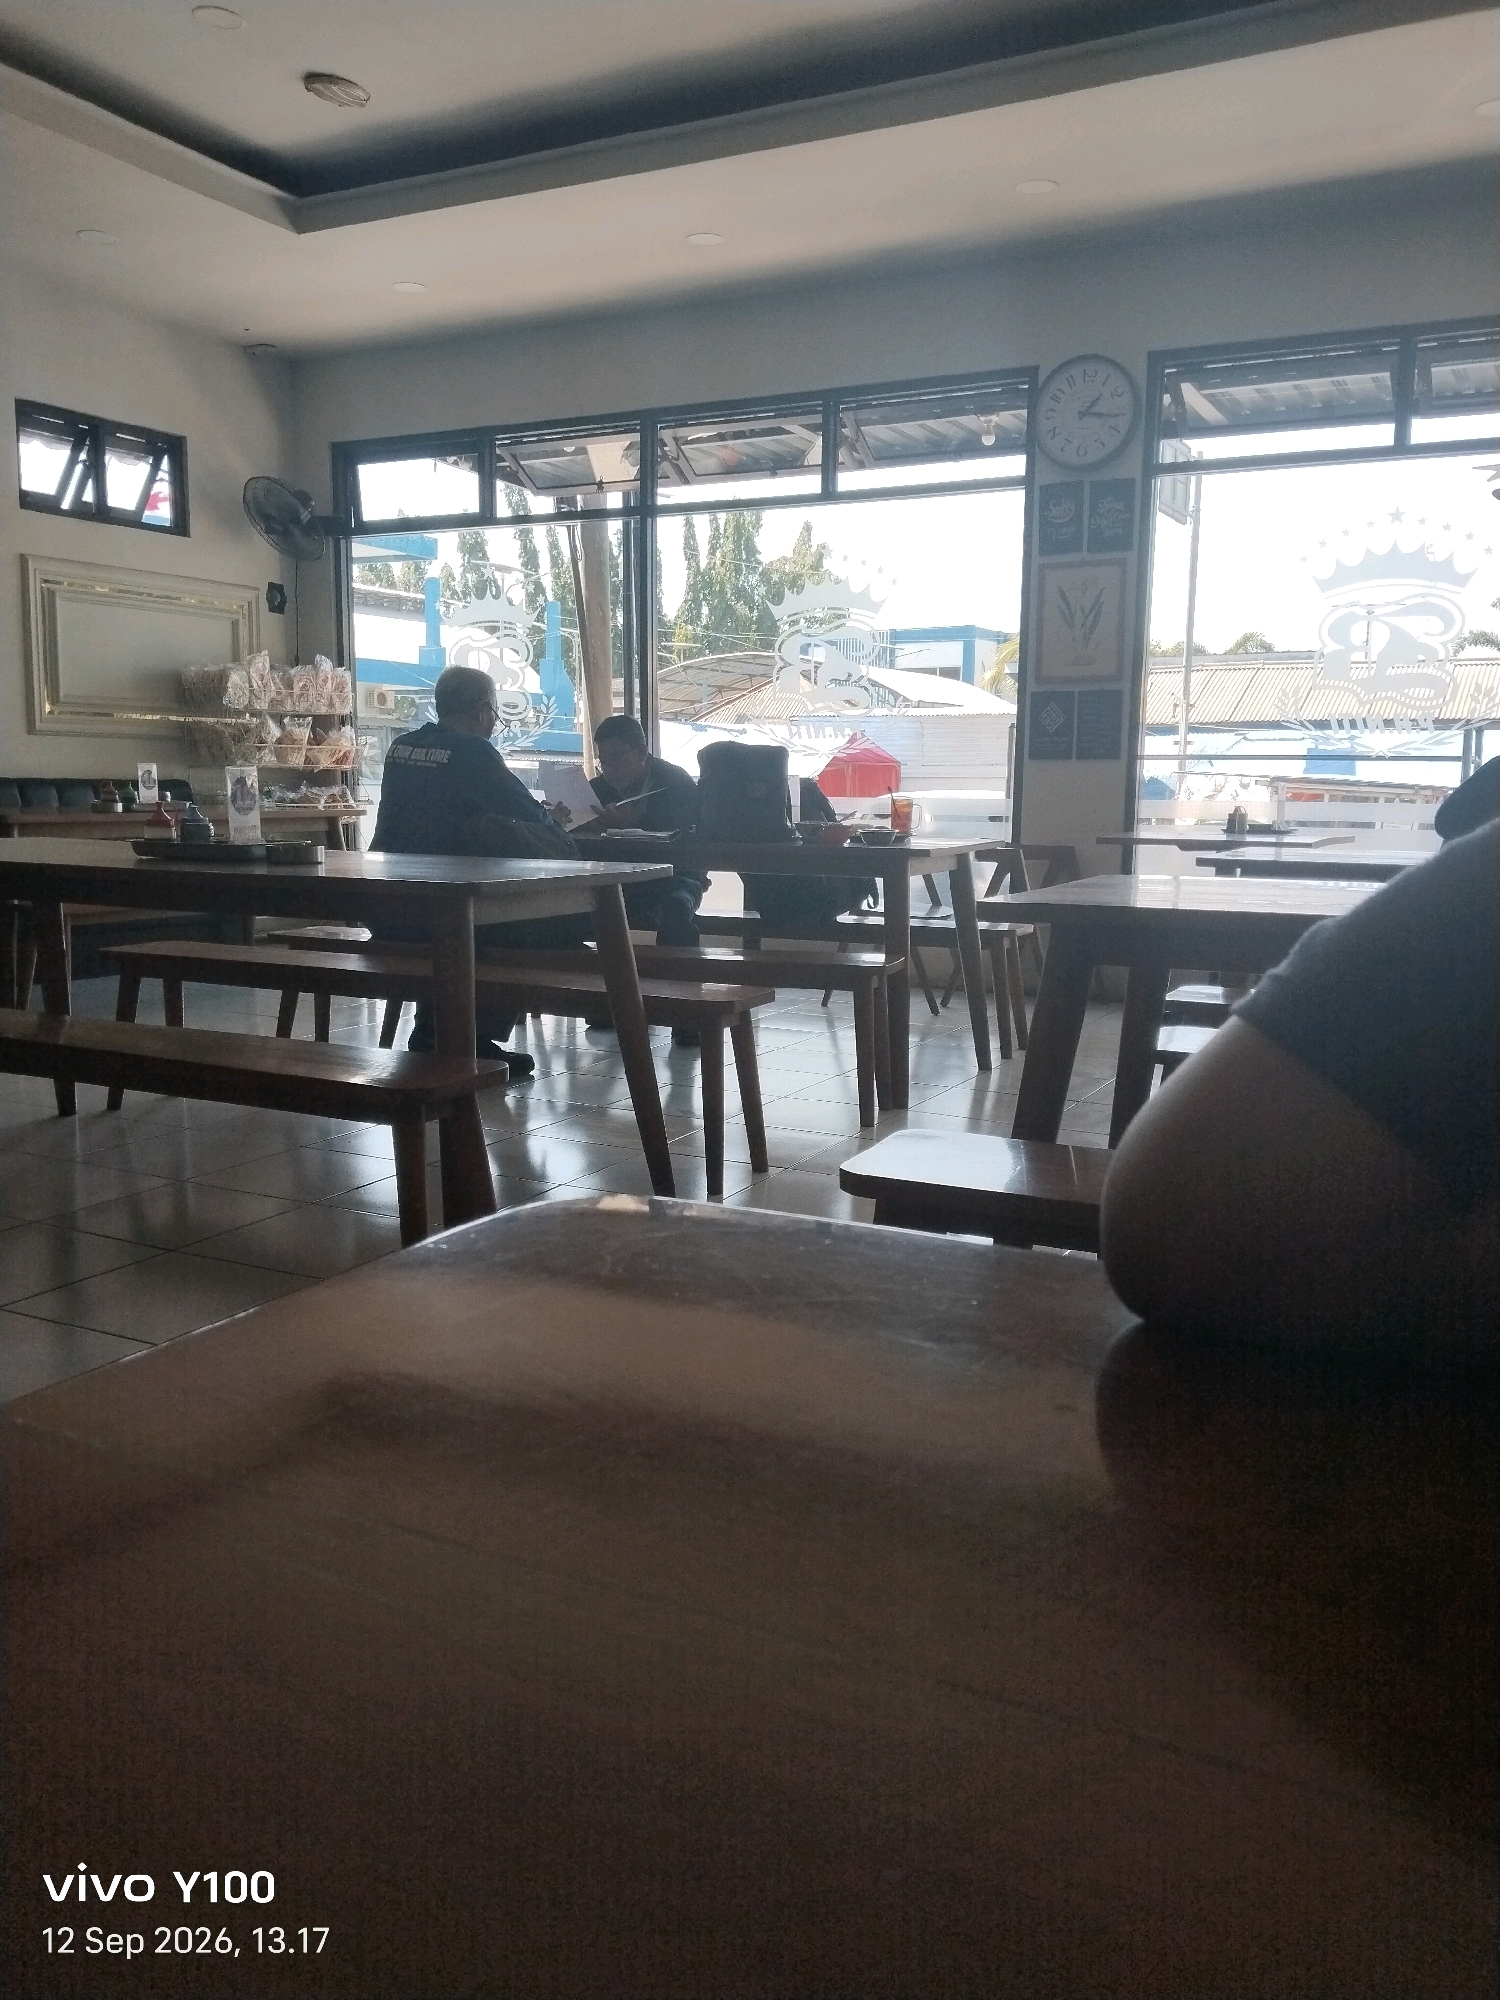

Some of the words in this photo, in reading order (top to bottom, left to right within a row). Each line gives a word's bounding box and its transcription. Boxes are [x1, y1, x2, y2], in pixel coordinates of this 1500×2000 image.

[1065, 374, 1077, 390] 11
[1102, 373, 1111, 387] 1
[1049, 388, 1066, 404] 10
[1110, 385, 1124, 400] 2
[1044, 408, 1057, 421] 9
[1046, 425, 1061, 441] 8
[1060, 437, 1073, 453] 7
[1076, 444, 1088, 458] 6
[410, 747, 451, 764] CULTURE
